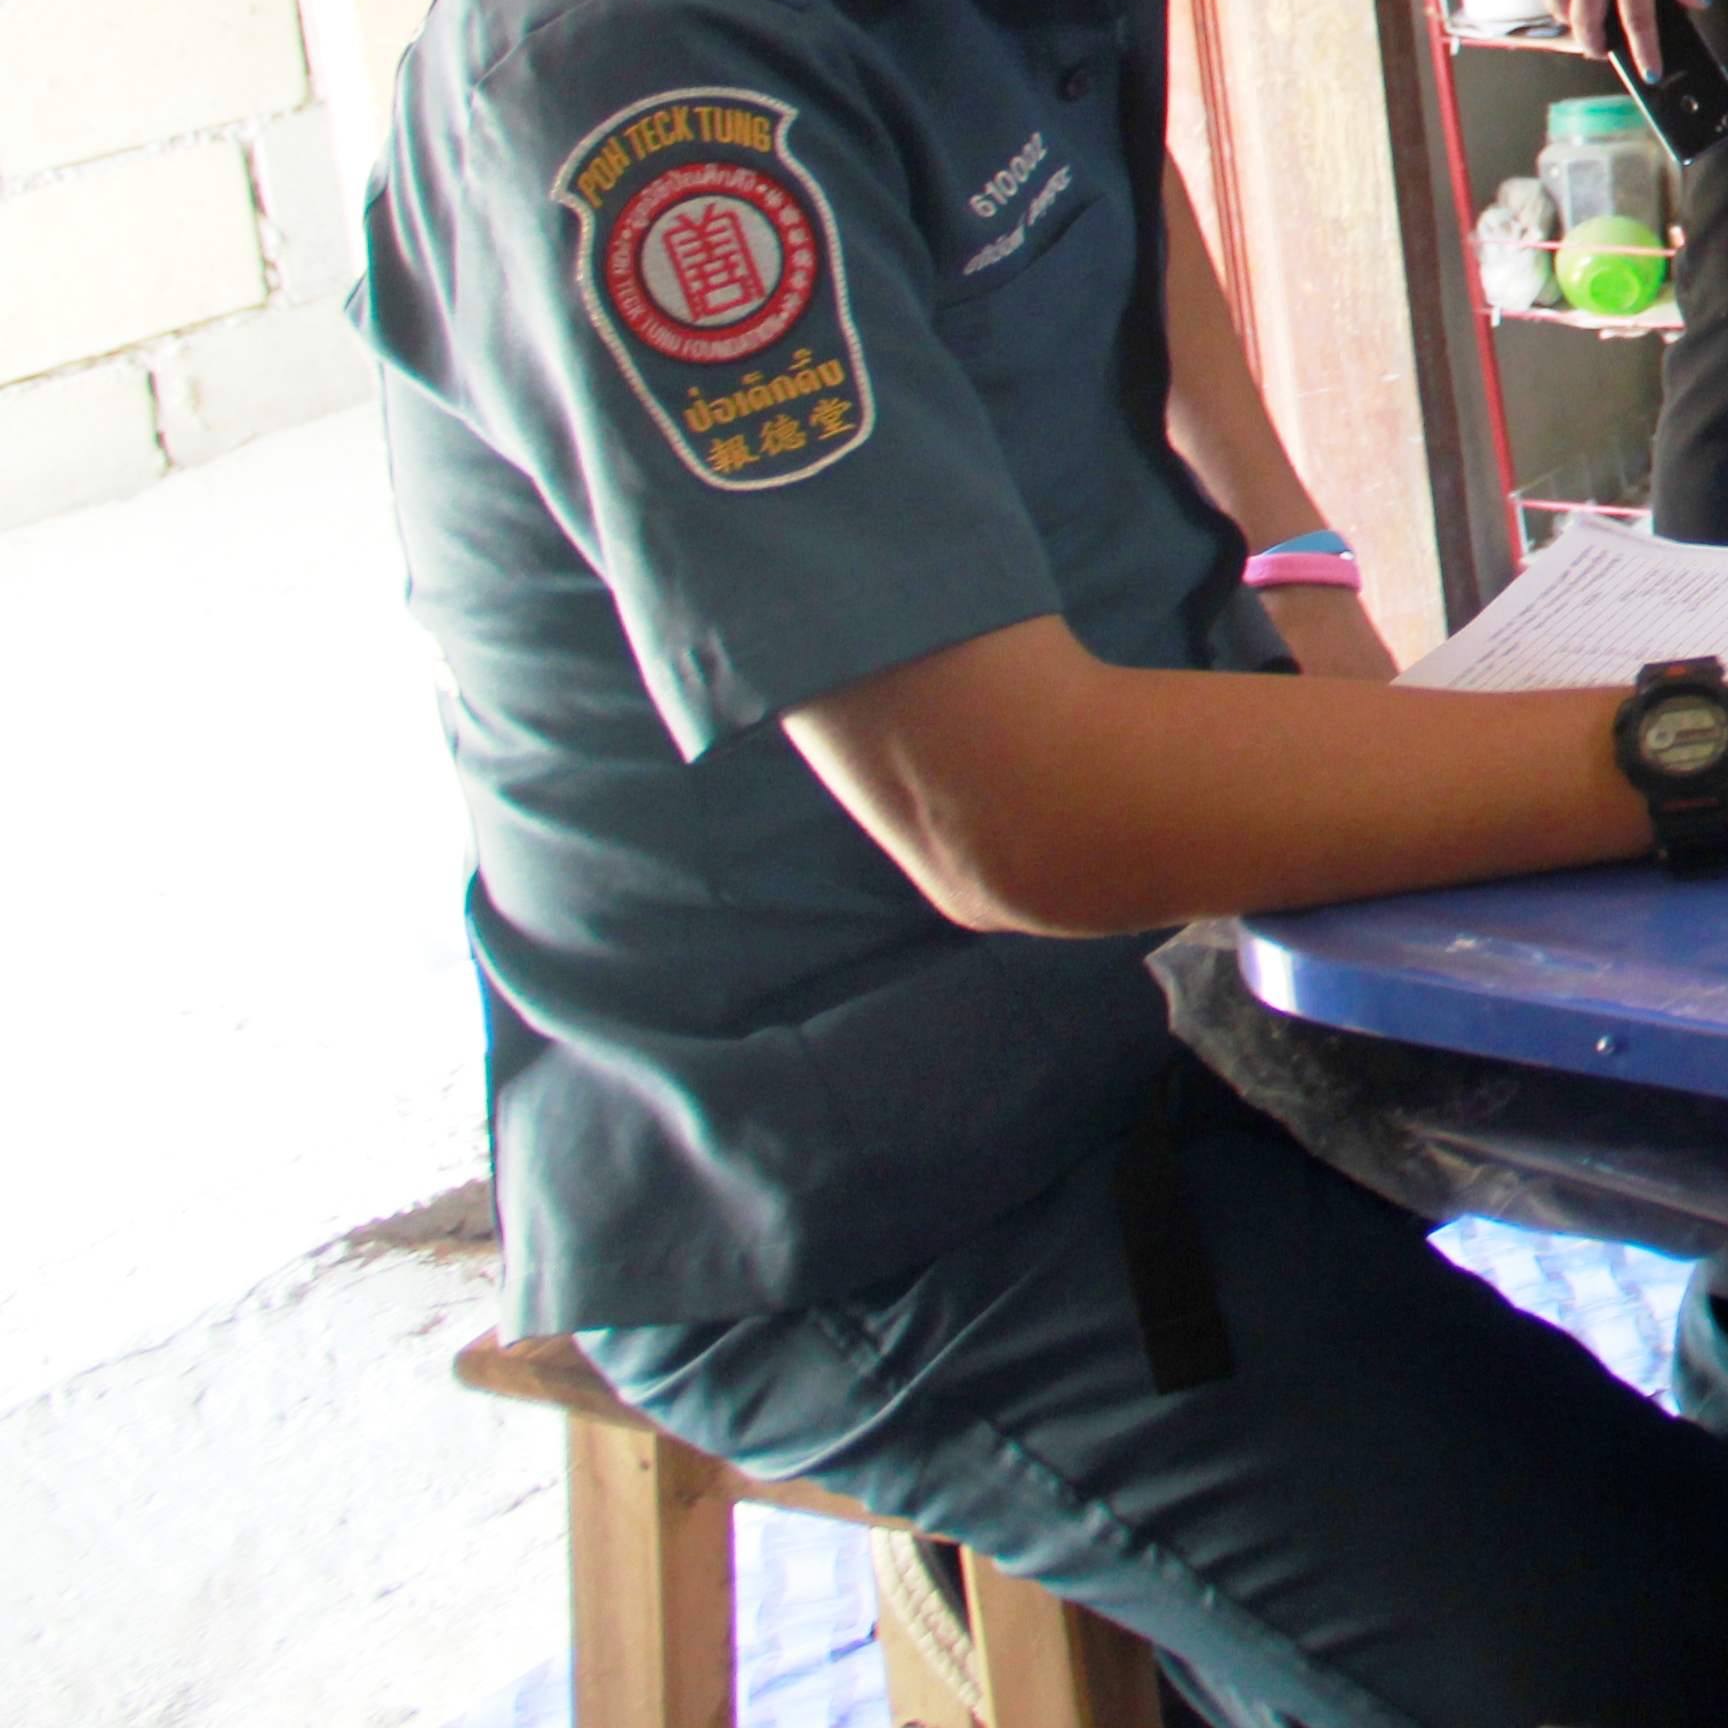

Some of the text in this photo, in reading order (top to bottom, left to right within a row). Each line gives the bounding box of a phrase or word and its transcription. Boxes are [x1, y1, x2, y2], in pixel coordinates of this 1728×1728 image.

[577, 136, 631, 210] POH
[623, 105, 694, 160] TECK
[692, 106, 773, 153] TUNG
